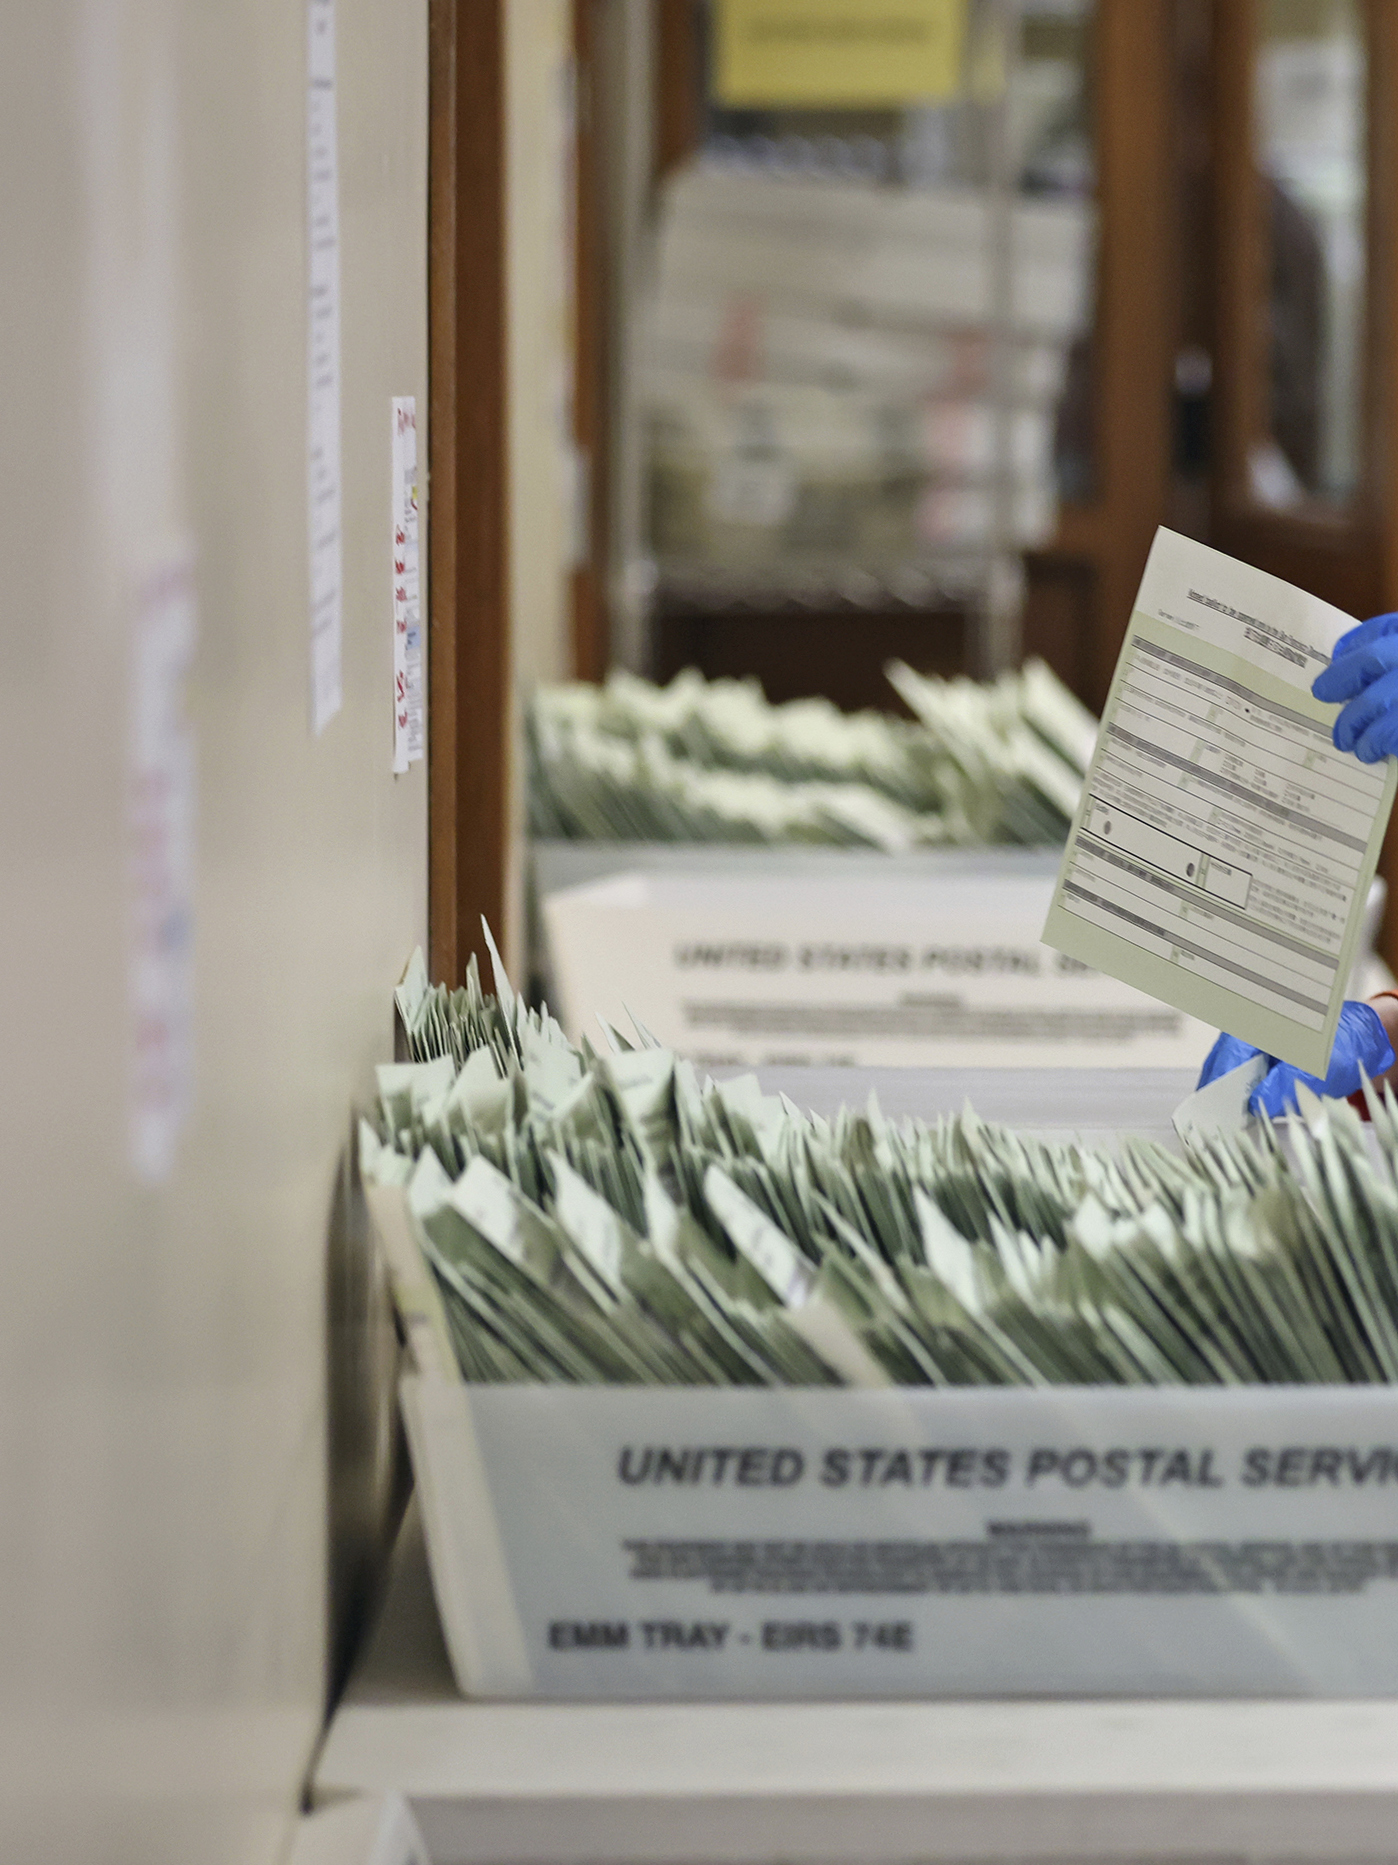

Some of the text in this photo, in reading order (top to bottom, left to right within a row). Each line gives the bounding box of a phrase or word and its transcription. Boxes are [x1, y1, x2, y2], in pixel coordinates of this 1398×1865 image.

[616, 1445, 806, 1488] UNITED
[819, 1446, 1011, 1489] STATES
[1026, 1446, 1222, 1488] POSTAL
[547, 1620, 629, 1651] EMM
[641, 1620, 729, 1651] TRAY
[761, 1621, 842, 1652] EIRS
[855, 1621, 912, 1652] 74E
